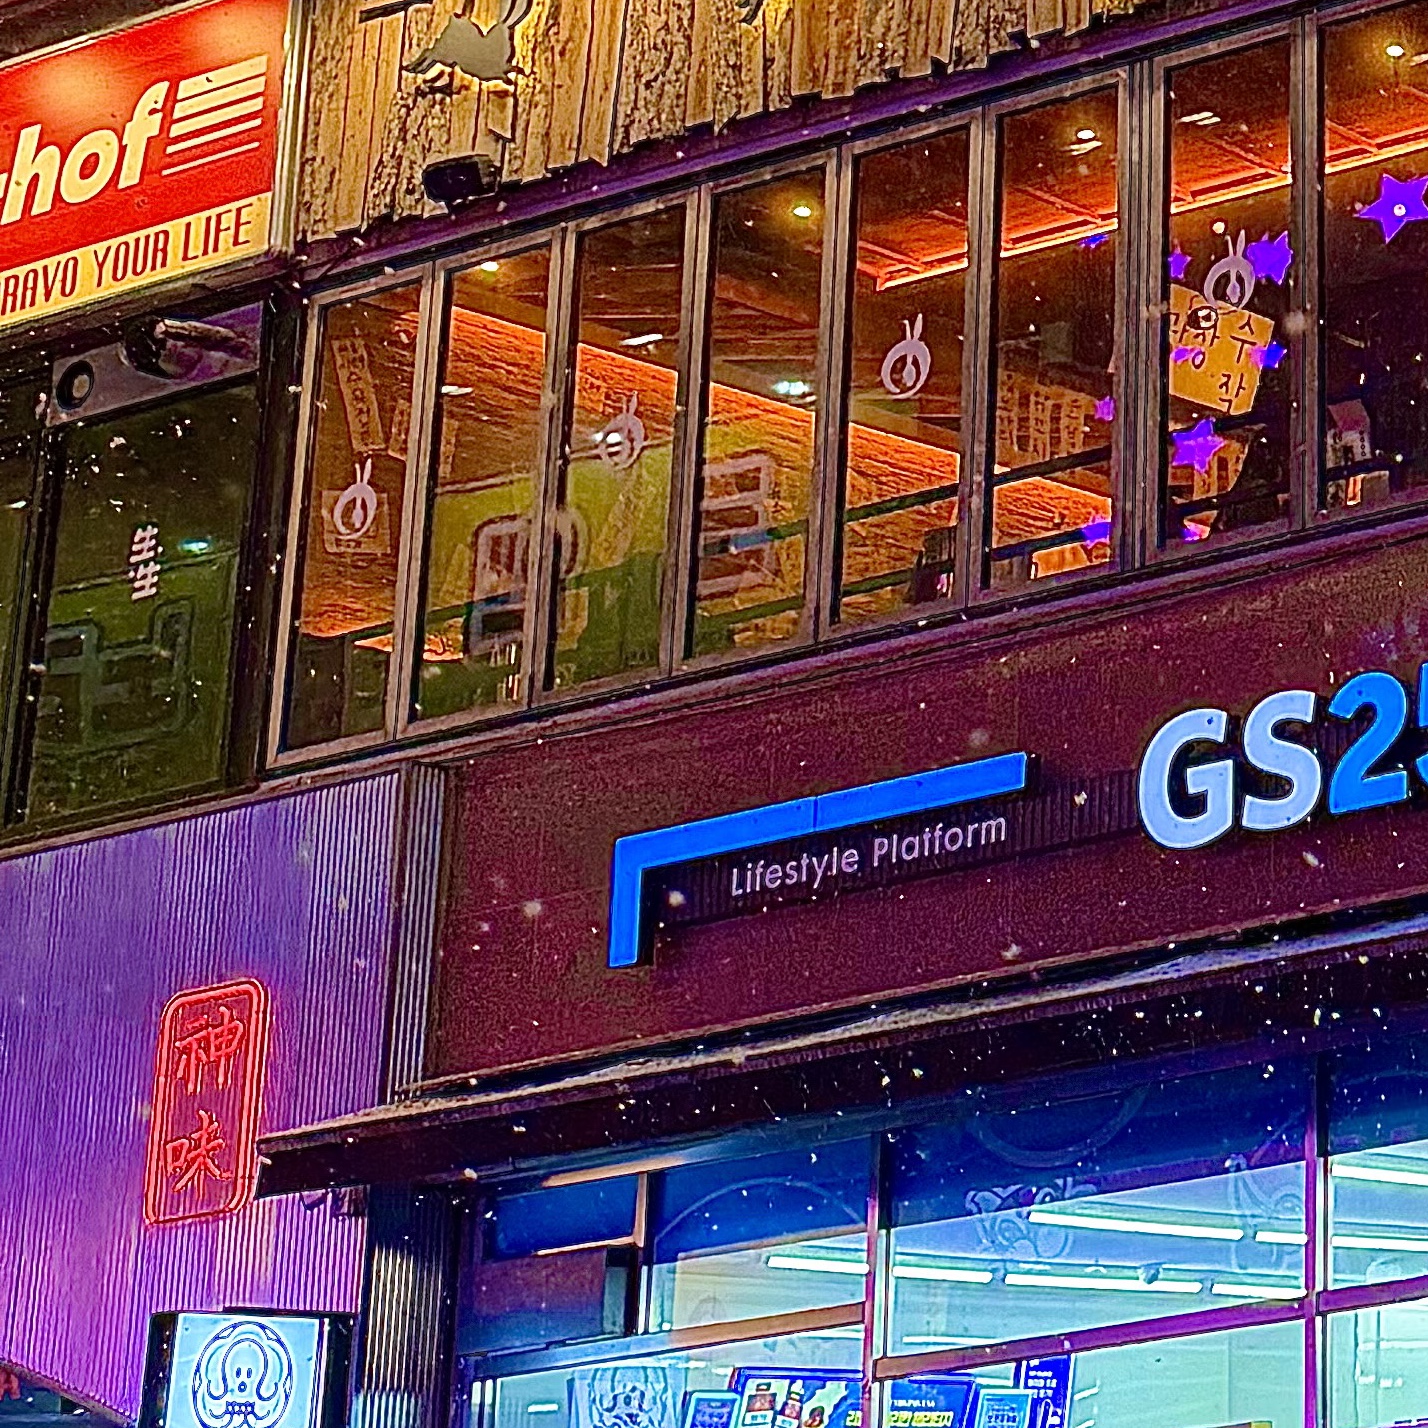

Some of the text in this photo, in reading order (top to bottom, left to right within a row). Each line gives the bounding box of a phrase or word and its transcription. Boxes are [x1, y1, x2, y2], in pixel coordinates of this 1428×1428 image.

[93, 232, 170, 290] YOUR
[181, 202, 253, 265] LIFE
[730, 815, 1008, 897] Lifestyle Platform
[164, 1003, 247, 1201] 神味
